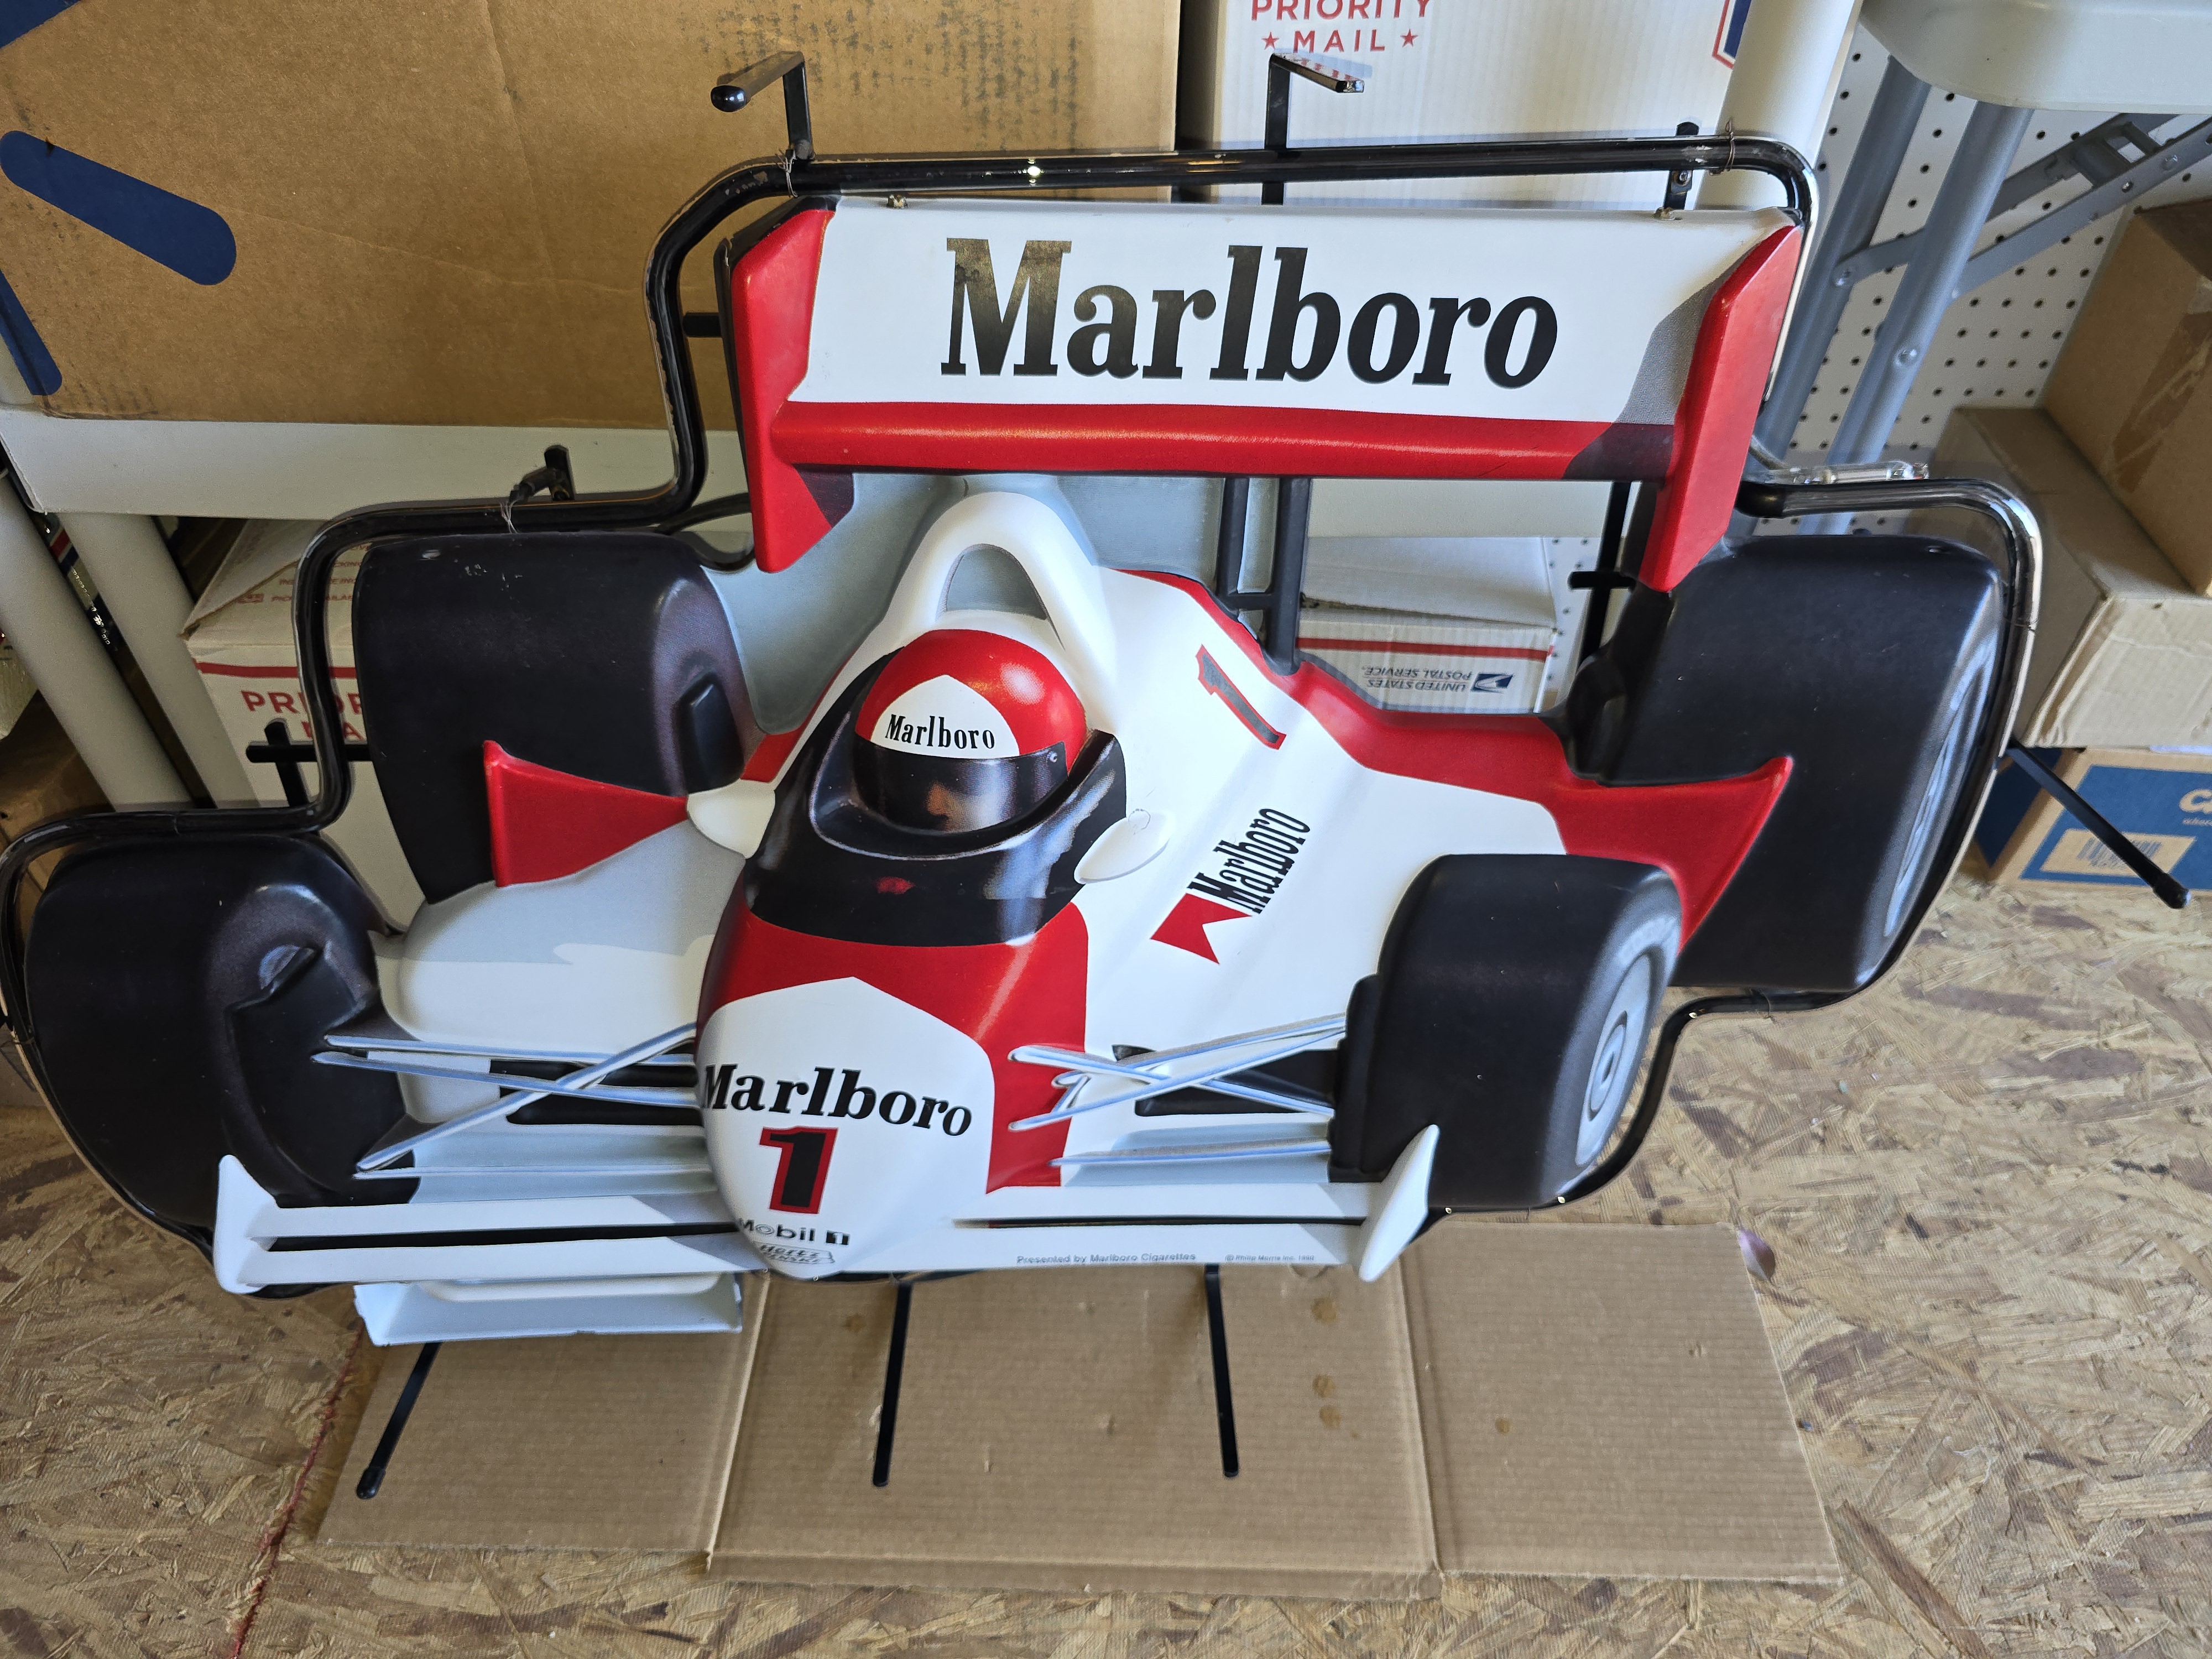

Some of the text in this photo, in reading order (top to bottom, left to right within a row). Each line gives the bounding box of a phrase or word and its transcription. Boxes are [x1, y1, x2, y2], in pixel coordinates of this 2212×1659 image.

[1293, 29, 1385, 53] MAIL
[941, 238, 1558, 389] Marlboro
[1367, 679, 1467, 692] UNITED STATES
[1423, 669, 1472, 680] POSTAL
[1195, 644, 1287, 750] 1
[885, 714, 995, 749] Marlboro
[1186, 808, 1311, 914] Marlboro
[703, 1063, 972, 1136] Marlboro
[759, 1126, 838, 1214] 1
[737, 1218, 815, 1241] Mobil
[1016, 1253, 1196, 1264] Presented by Marlboro Cigarettes
